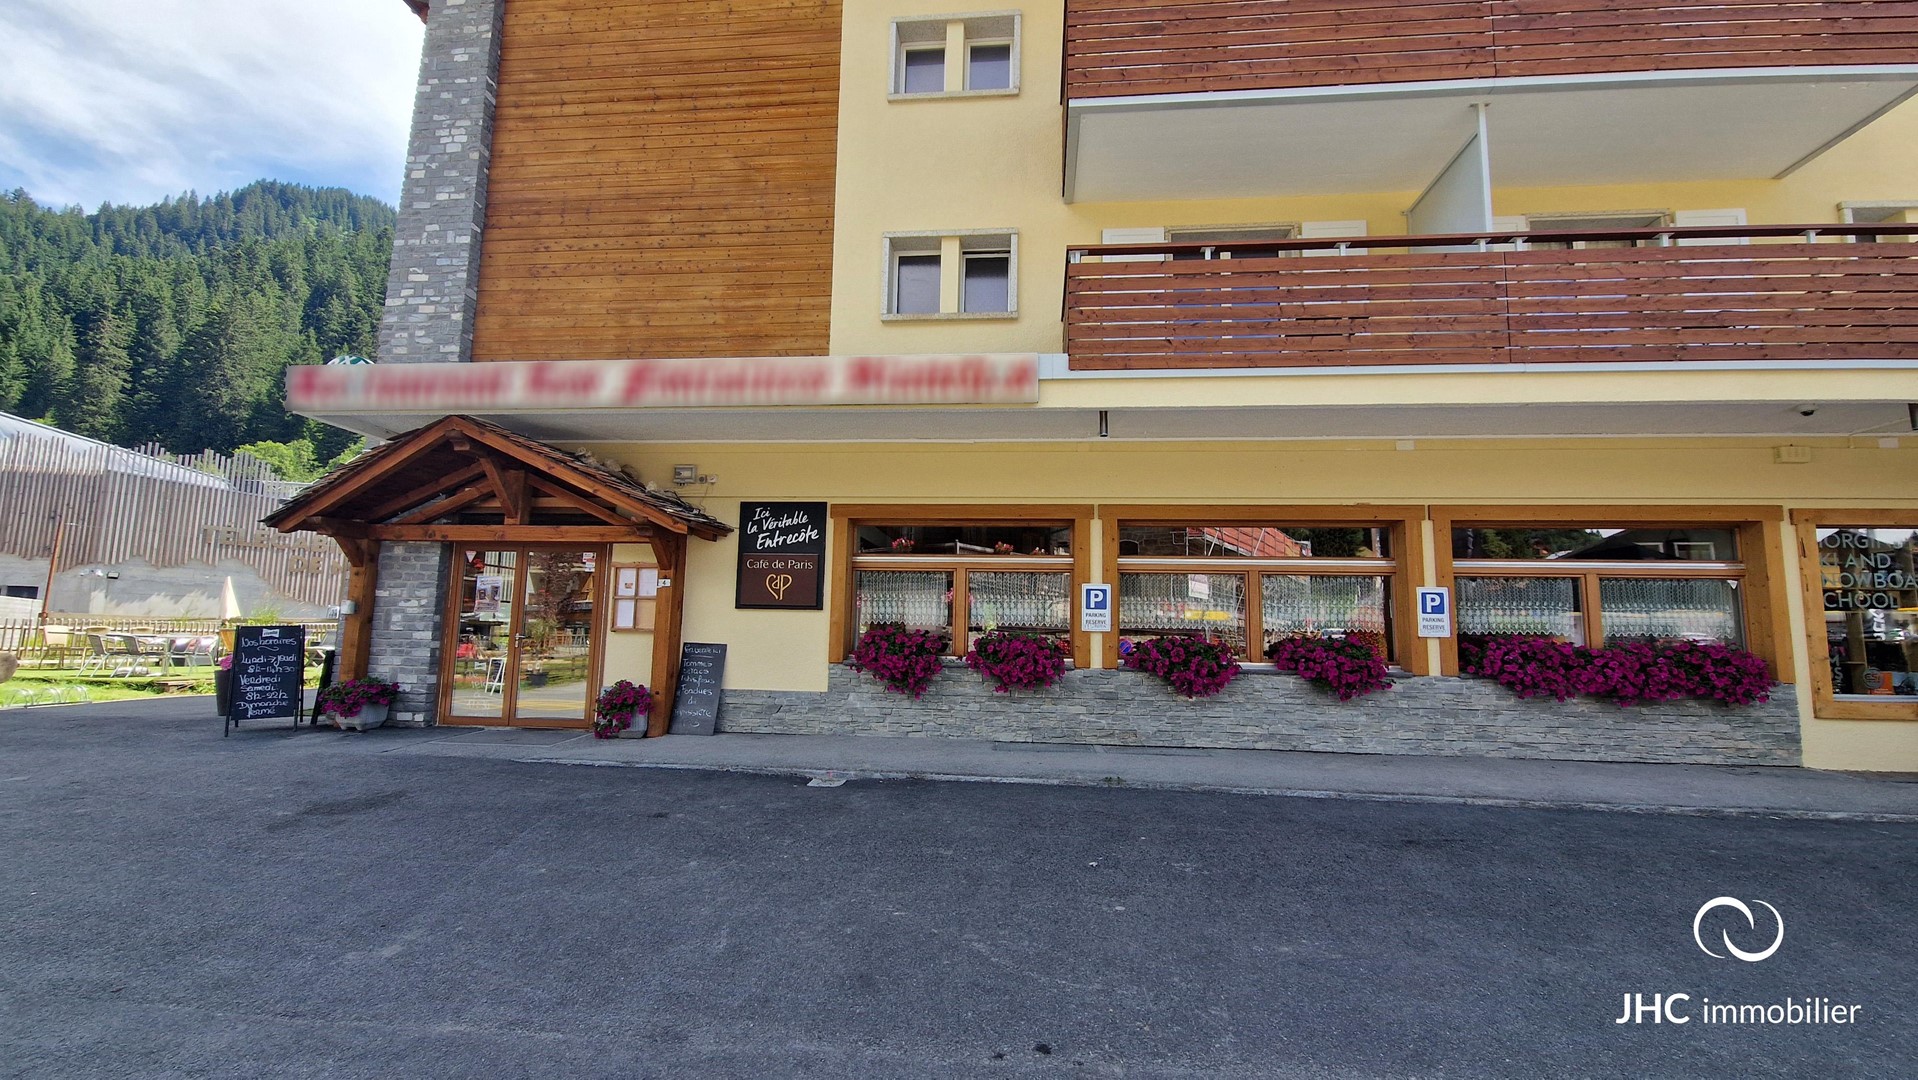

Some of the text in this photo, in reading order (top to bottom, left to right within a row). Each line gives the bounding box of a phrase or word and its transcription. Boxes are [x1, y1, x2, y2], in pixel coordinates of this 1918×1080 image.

[753, 507, 771, 520] Ici
[747, 511, 809, 534] la Véritable
[756, 525, 819, 550] Entrecôte
[289, 554, 322, 574] DE
[746, 558, 814, 569] Café de Paris
[1844, 553, 1891, 569] AND
[1090, 590, 1104, 608] P
[1426, 594, 1441, 613] P
[1824, 592, 1899, 608] CHOOL
[241, 636, 297, 647] Nos horaires
[241, 652, 267, 664] Lundi
[240, 674, 281, 685] Vendredi
[236, 700, 288, 710] Dimanche
